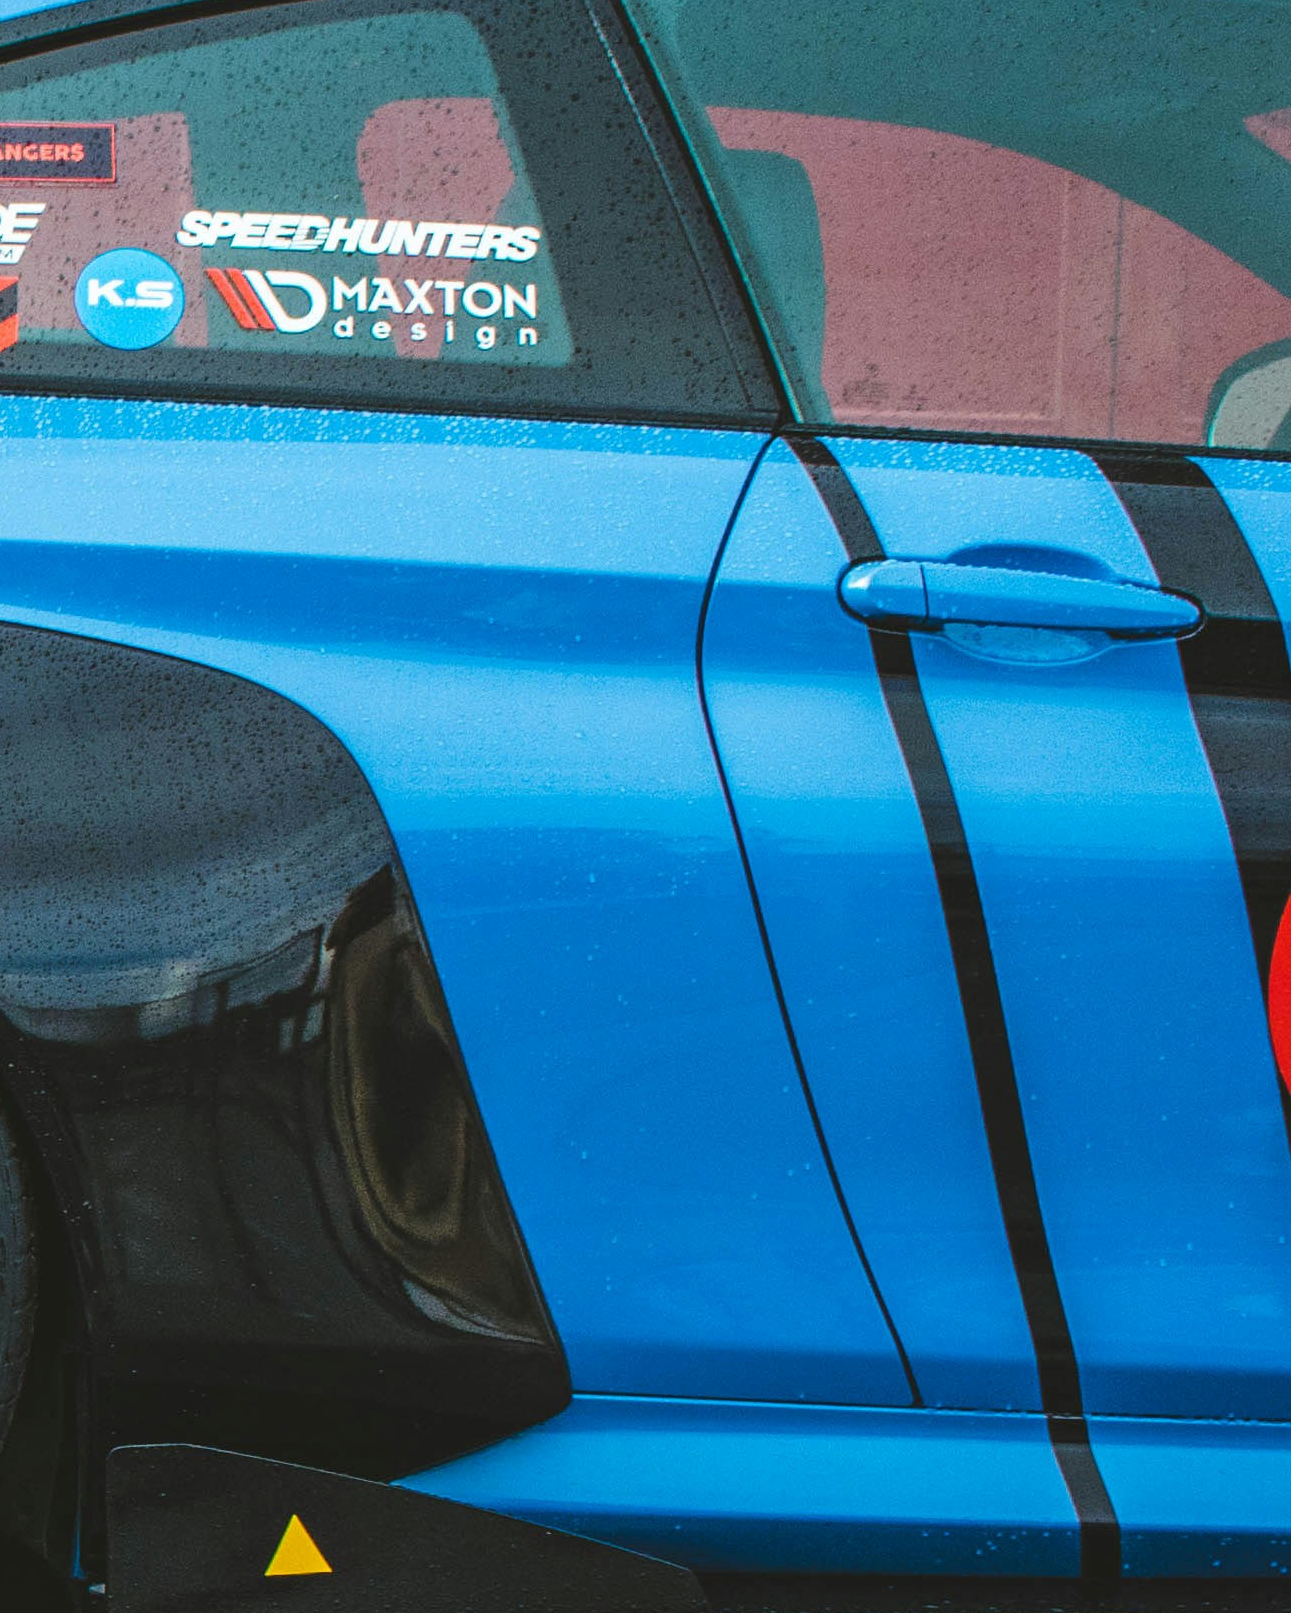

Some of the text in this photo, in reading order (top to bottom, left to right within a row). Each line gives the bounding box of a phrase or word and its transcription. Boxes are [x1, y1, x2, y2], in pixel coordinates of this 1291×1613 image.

[175, 209, 541, 263] SPEEDHUNTERS
[86, 278, 175, 309] K.S
[332, 275, 537, 320] MAXTON
[333, 315, 538, 350] design
